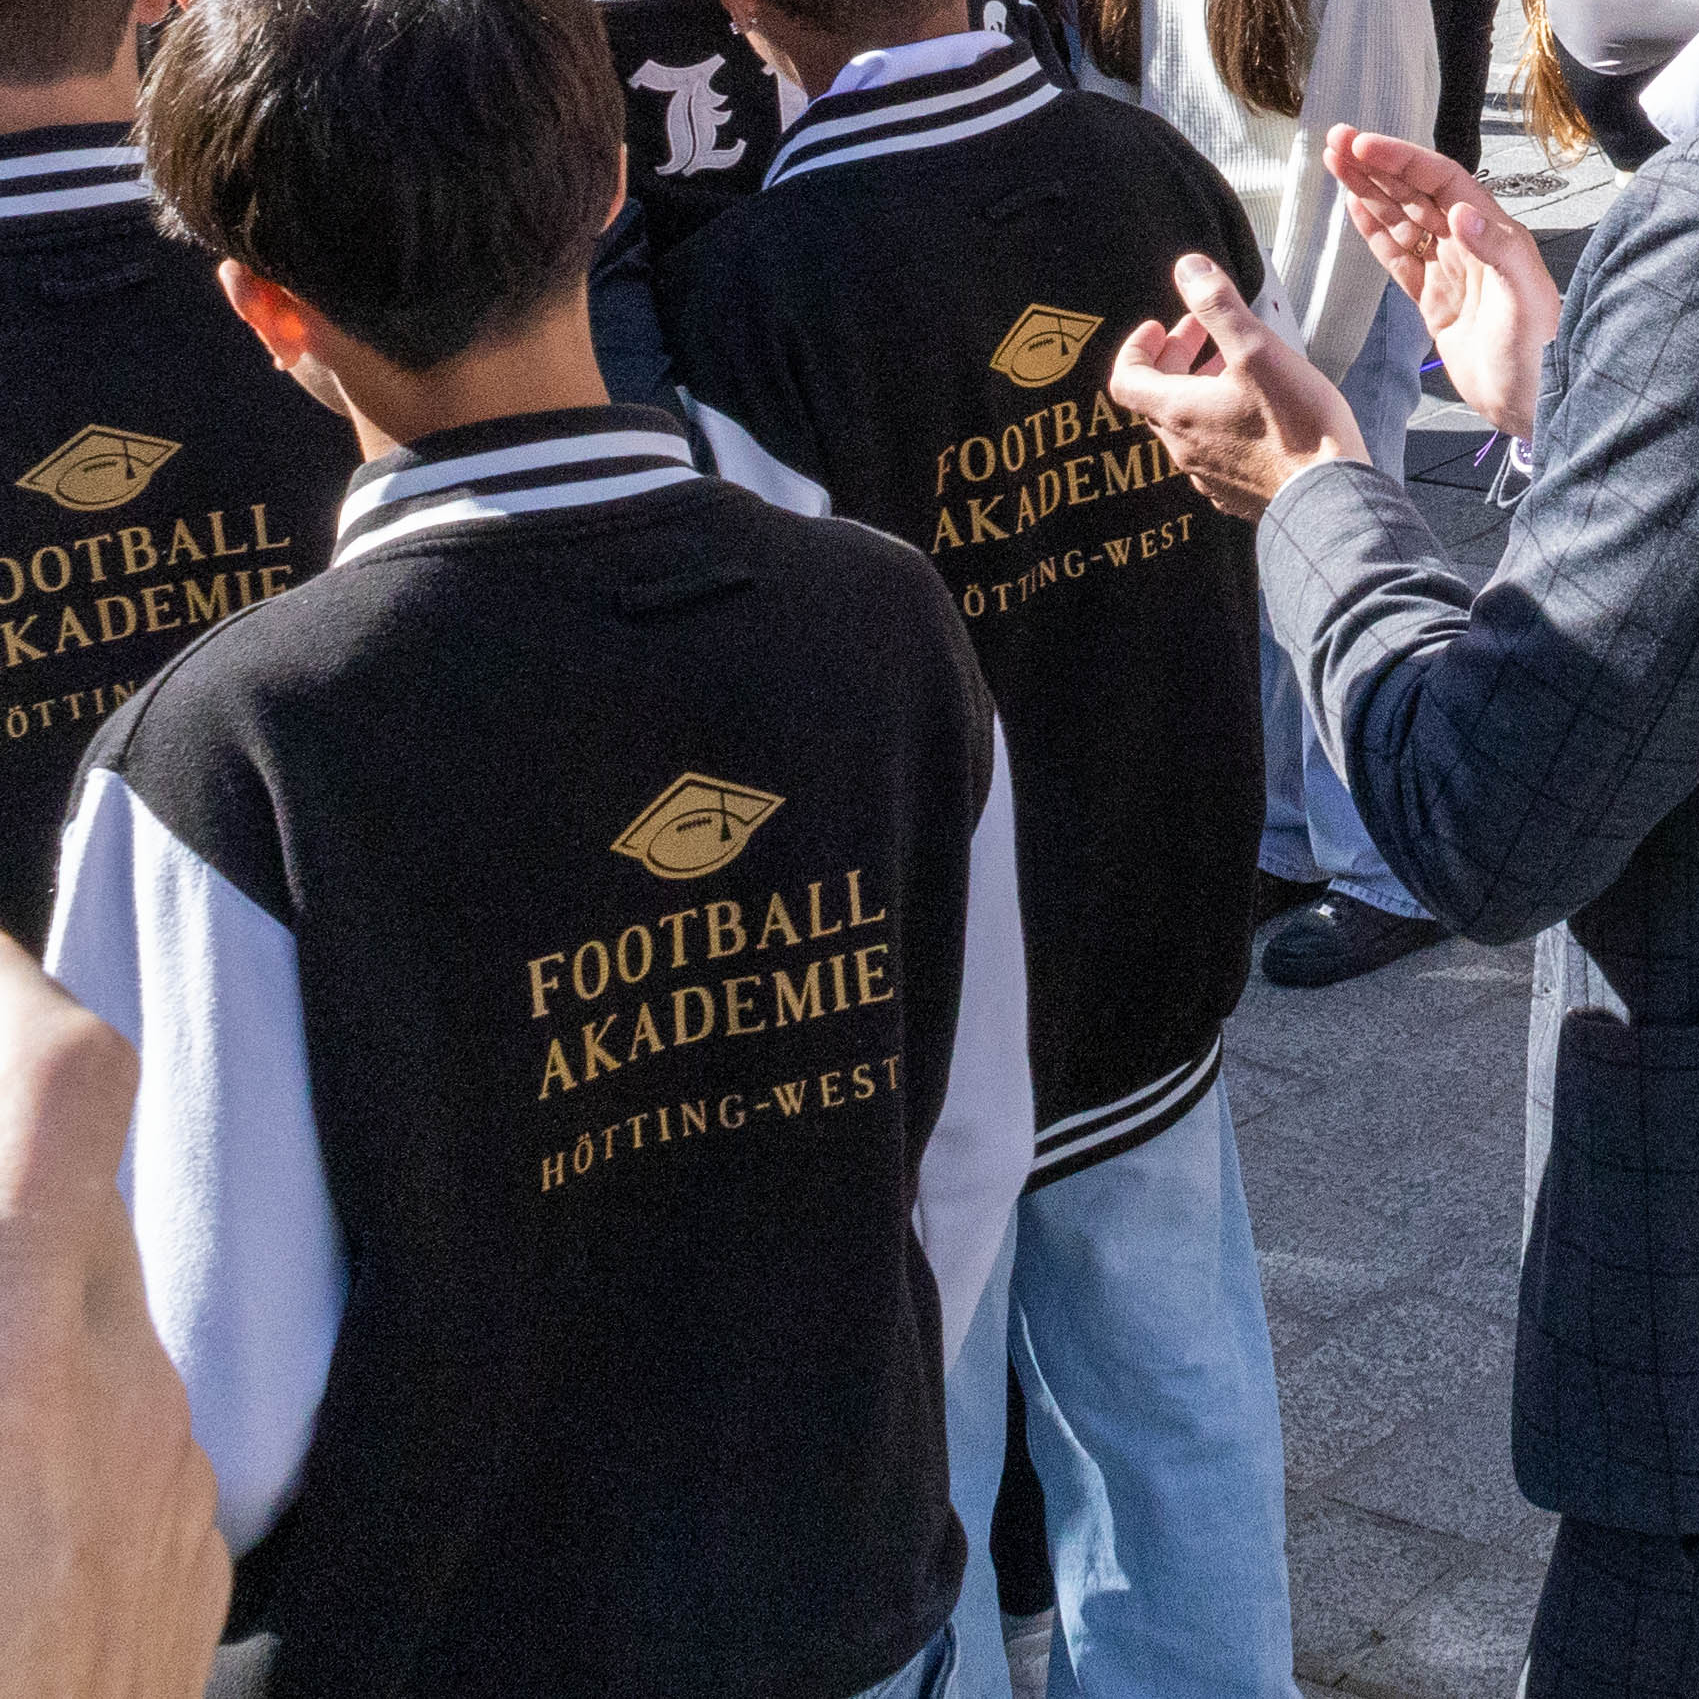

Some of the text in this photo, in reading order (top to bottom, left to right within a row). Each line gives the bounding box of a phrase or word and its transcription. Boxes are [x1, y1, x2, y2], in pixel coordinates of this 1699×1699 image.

[935, 389, 1148, 498] FOOTBA
[0, 503, 292, 605] OOTBALL
[961, 512, 1194, 617] ÖTTING-WEST
[0, 564, 294, 669] KADEMIE
[527, 869, 886, 1019] FOOTBALL
[538, 943, 895, 1101] AKADEMIE
[540, 1054, 900, 1192] HÖTTING-WEST
